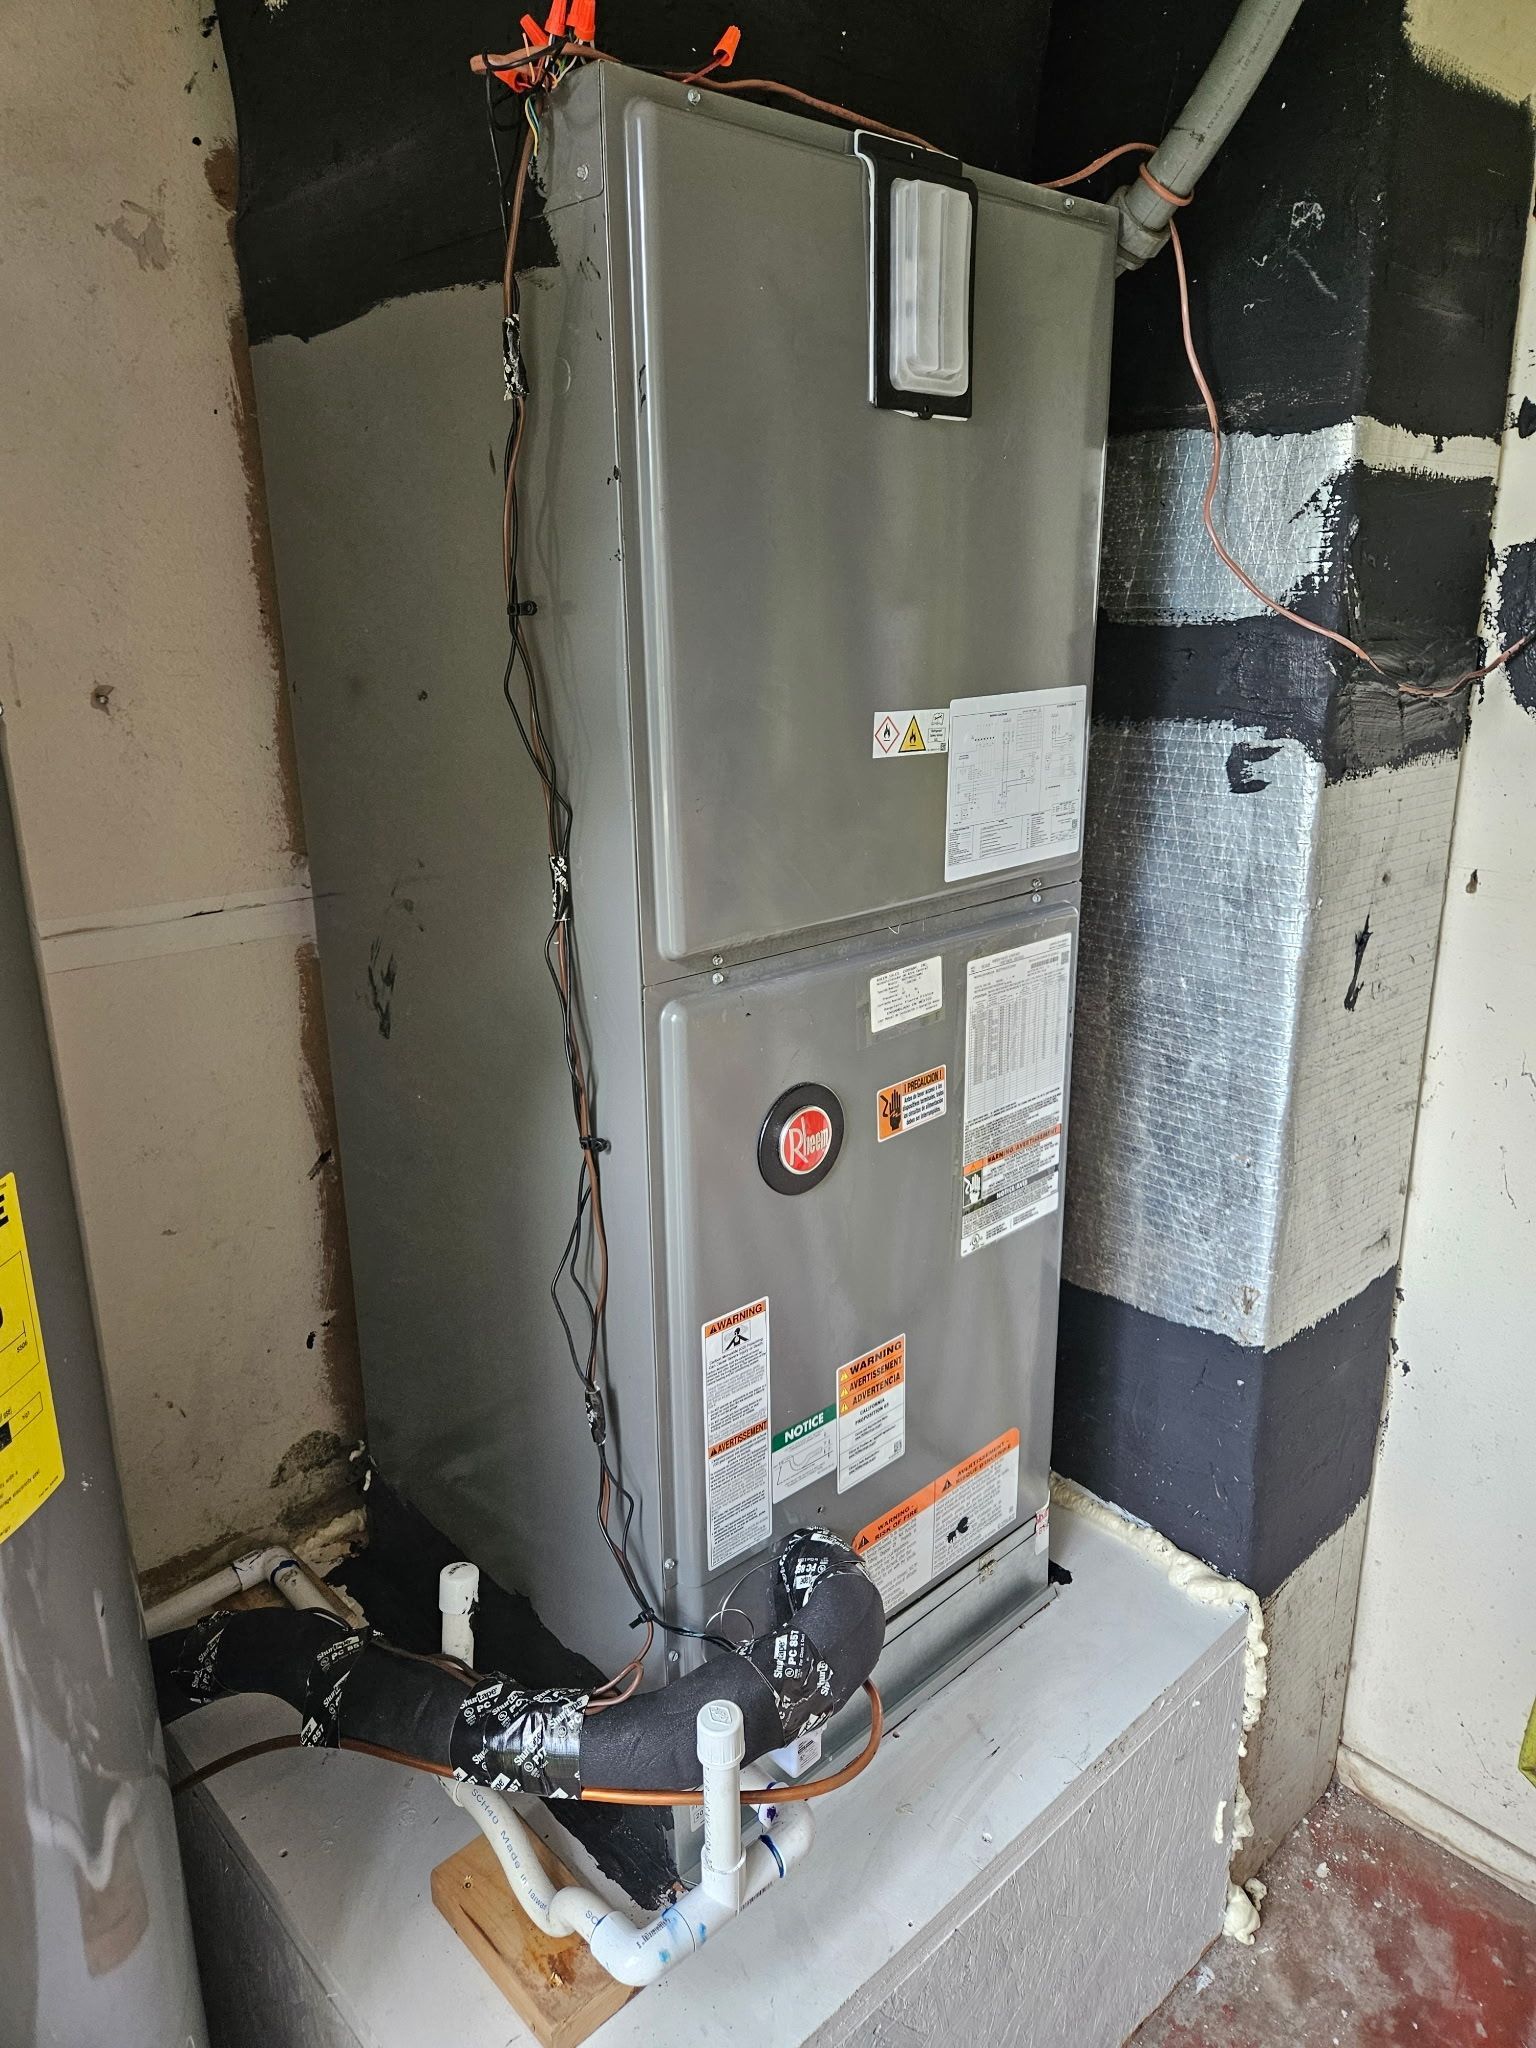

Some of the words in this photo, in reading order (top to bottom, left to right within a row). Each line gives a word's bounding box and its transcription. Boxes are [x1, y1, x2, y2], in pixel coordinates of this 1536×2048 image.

[788, 1116, 829, 1167] Rheem
[717, 1303, 763, 1331] WARNING
[849, 1341, 902, 1375] WARNING
[849, 1355, 903, 1392] AVERTISSEMENT
[852, 1372, 901, 1406] ADVERTENCIA
[855, 1406, 883, 1425] PROPOSITION
[860, 1398, 885, 1415] CALIFORNIA
[718, 1420, 767, 1454] AVERTISSEMENT
[784, 1412, 824, 1443] NOTICE
[958, 1442, 1005, 1476] AVERTISSEMENT
[874, 1528, 891, 1541] RISK
[892, 1517, 903, 1528] OF
[904, 1508, 918, 1521] FIRE
[877, 1506, 910, 1531] WARNING
[789, 1630, 800, 1647] 857
[774, 1634, 788, 1679] Shurtape
[788, 1649, 798, 1666] PC
[460, 1685, 499, 1710] Shurtape
[476, 1701, 491, 1713] PC
[549, 1698, 583, 1730] Shurtape
[472, 1788, 499, 1825] SCH40
[500, 1830, 521, 1869] Made
